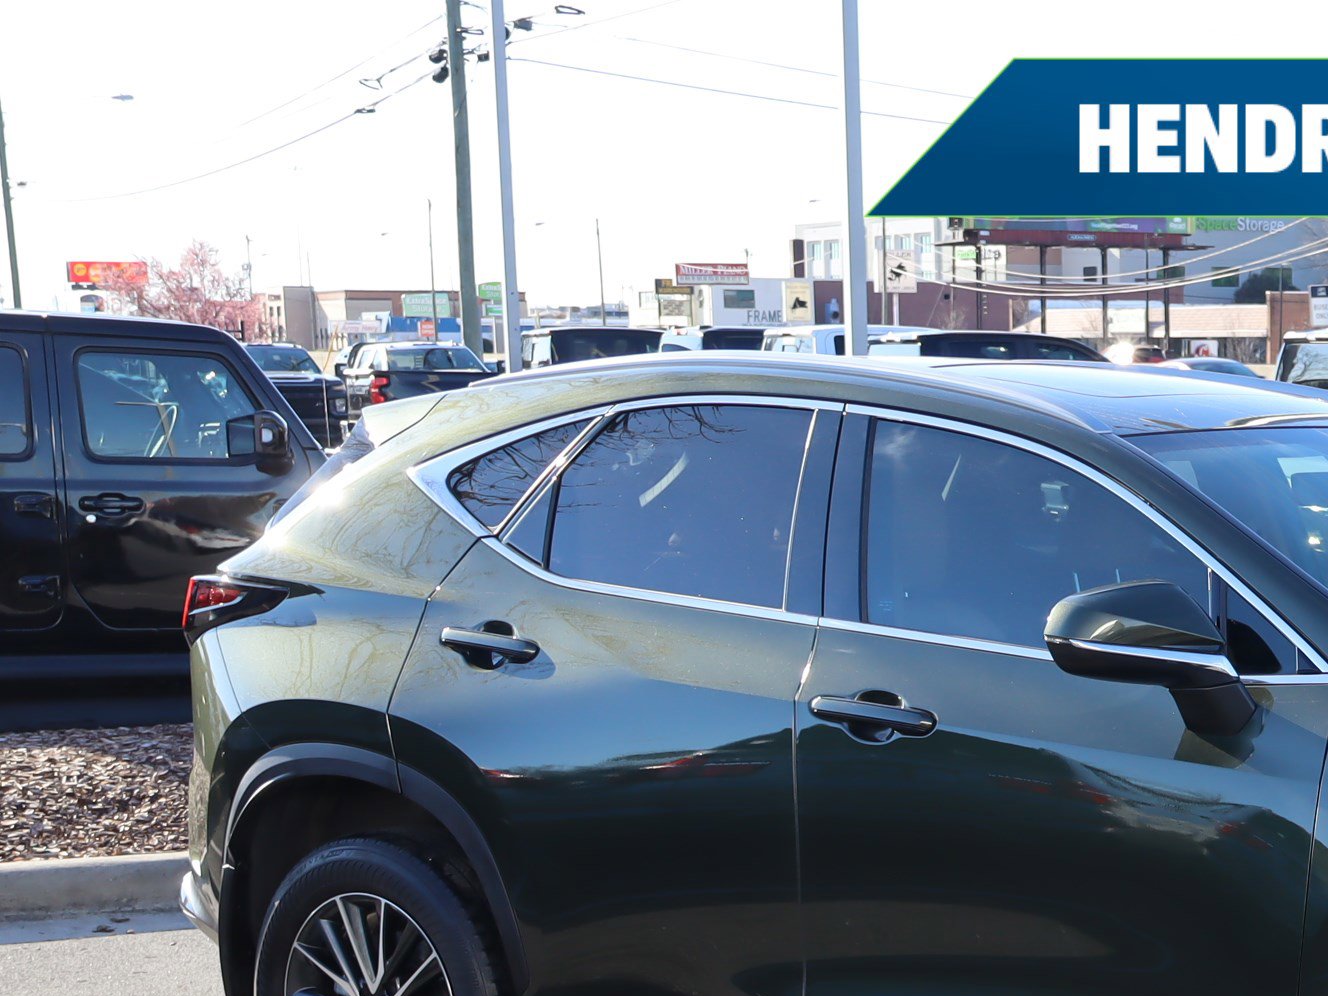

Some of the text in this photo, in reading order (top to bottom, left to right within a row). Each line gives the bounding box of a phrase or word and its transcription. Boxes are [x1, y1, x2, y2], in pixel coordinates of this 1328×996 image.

[679, 265, 747, 276] MILLER PIANO
[746, 310, 783, 323] FRAME
